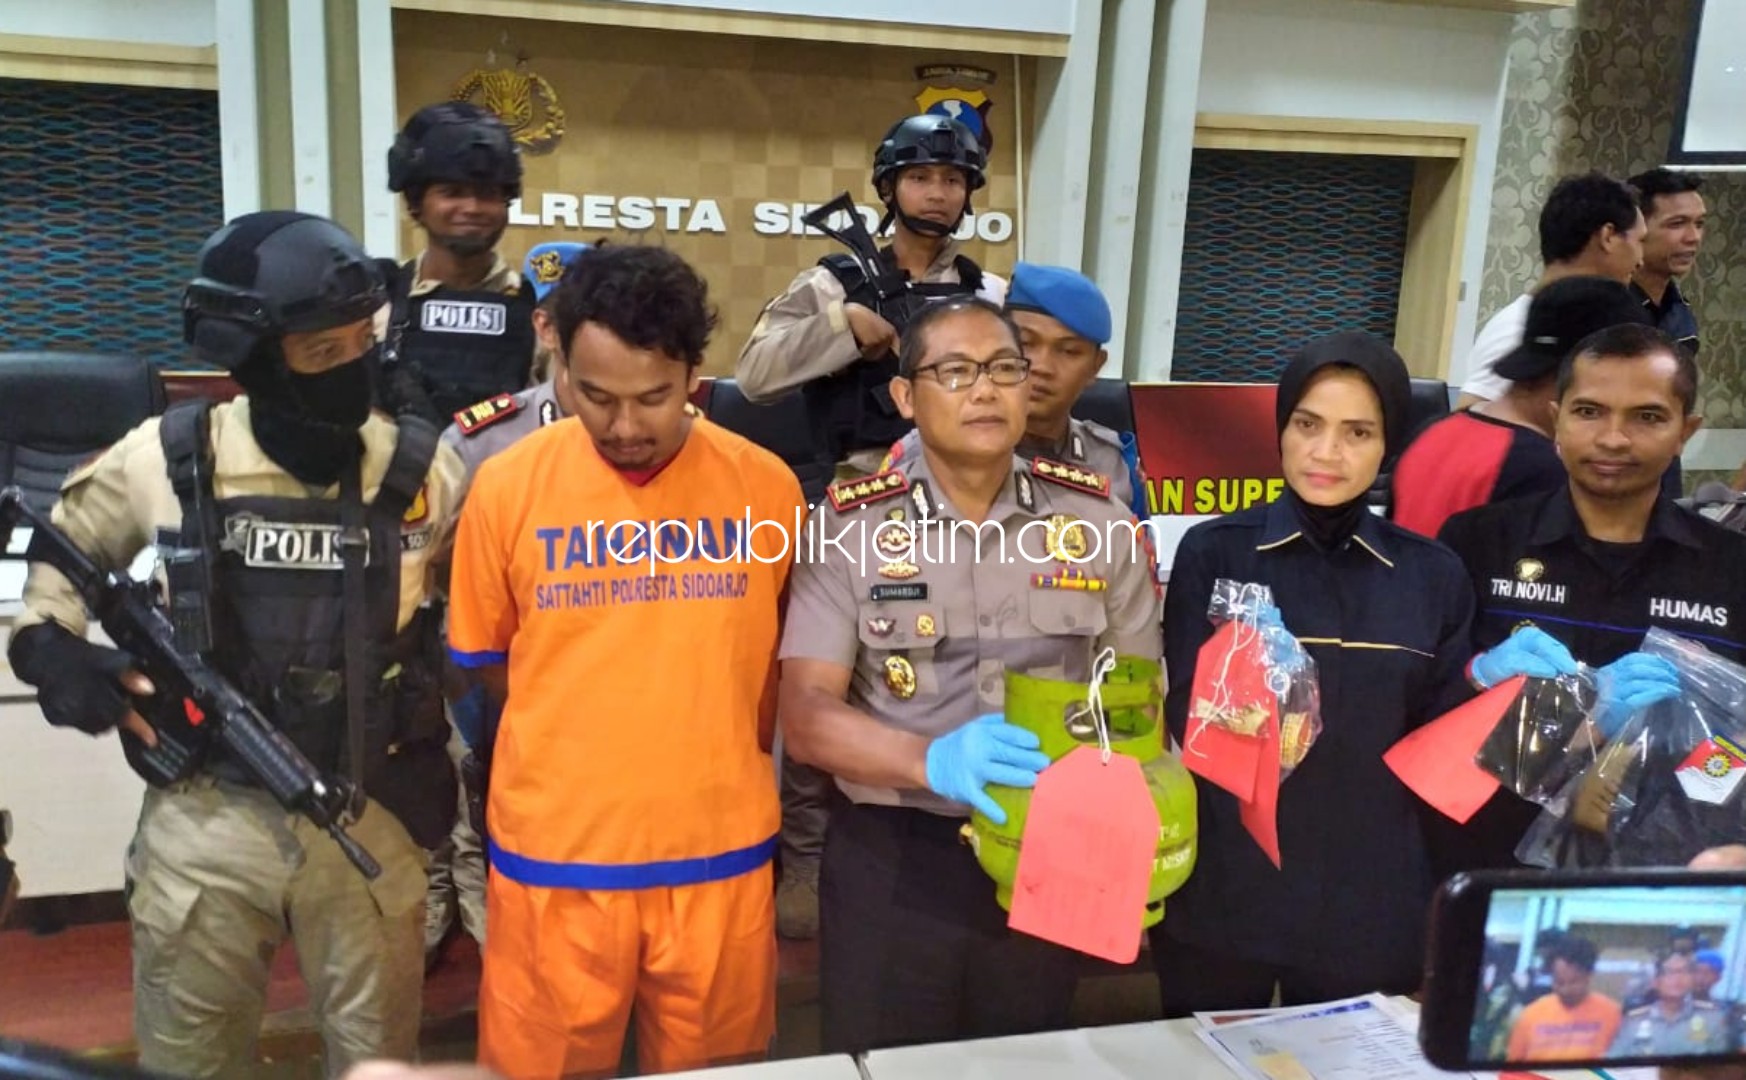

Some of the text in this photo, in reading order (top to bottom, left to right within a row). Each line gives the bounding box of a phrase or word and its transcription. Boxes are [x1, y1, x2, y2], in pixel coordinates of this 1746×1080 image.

[754, 202, 1012, 242] SIDOJO
[427, 304, 501, 331] POLISI
[536, 517, 752, 572] TAHANAN
[536, 572, 748, 610] SATTAHTI POLRESTA SIDOARJO
[1491, 578, 1566, 604] TRI NOVI.H
[1650, 598, 1728, 627] HUMAS
